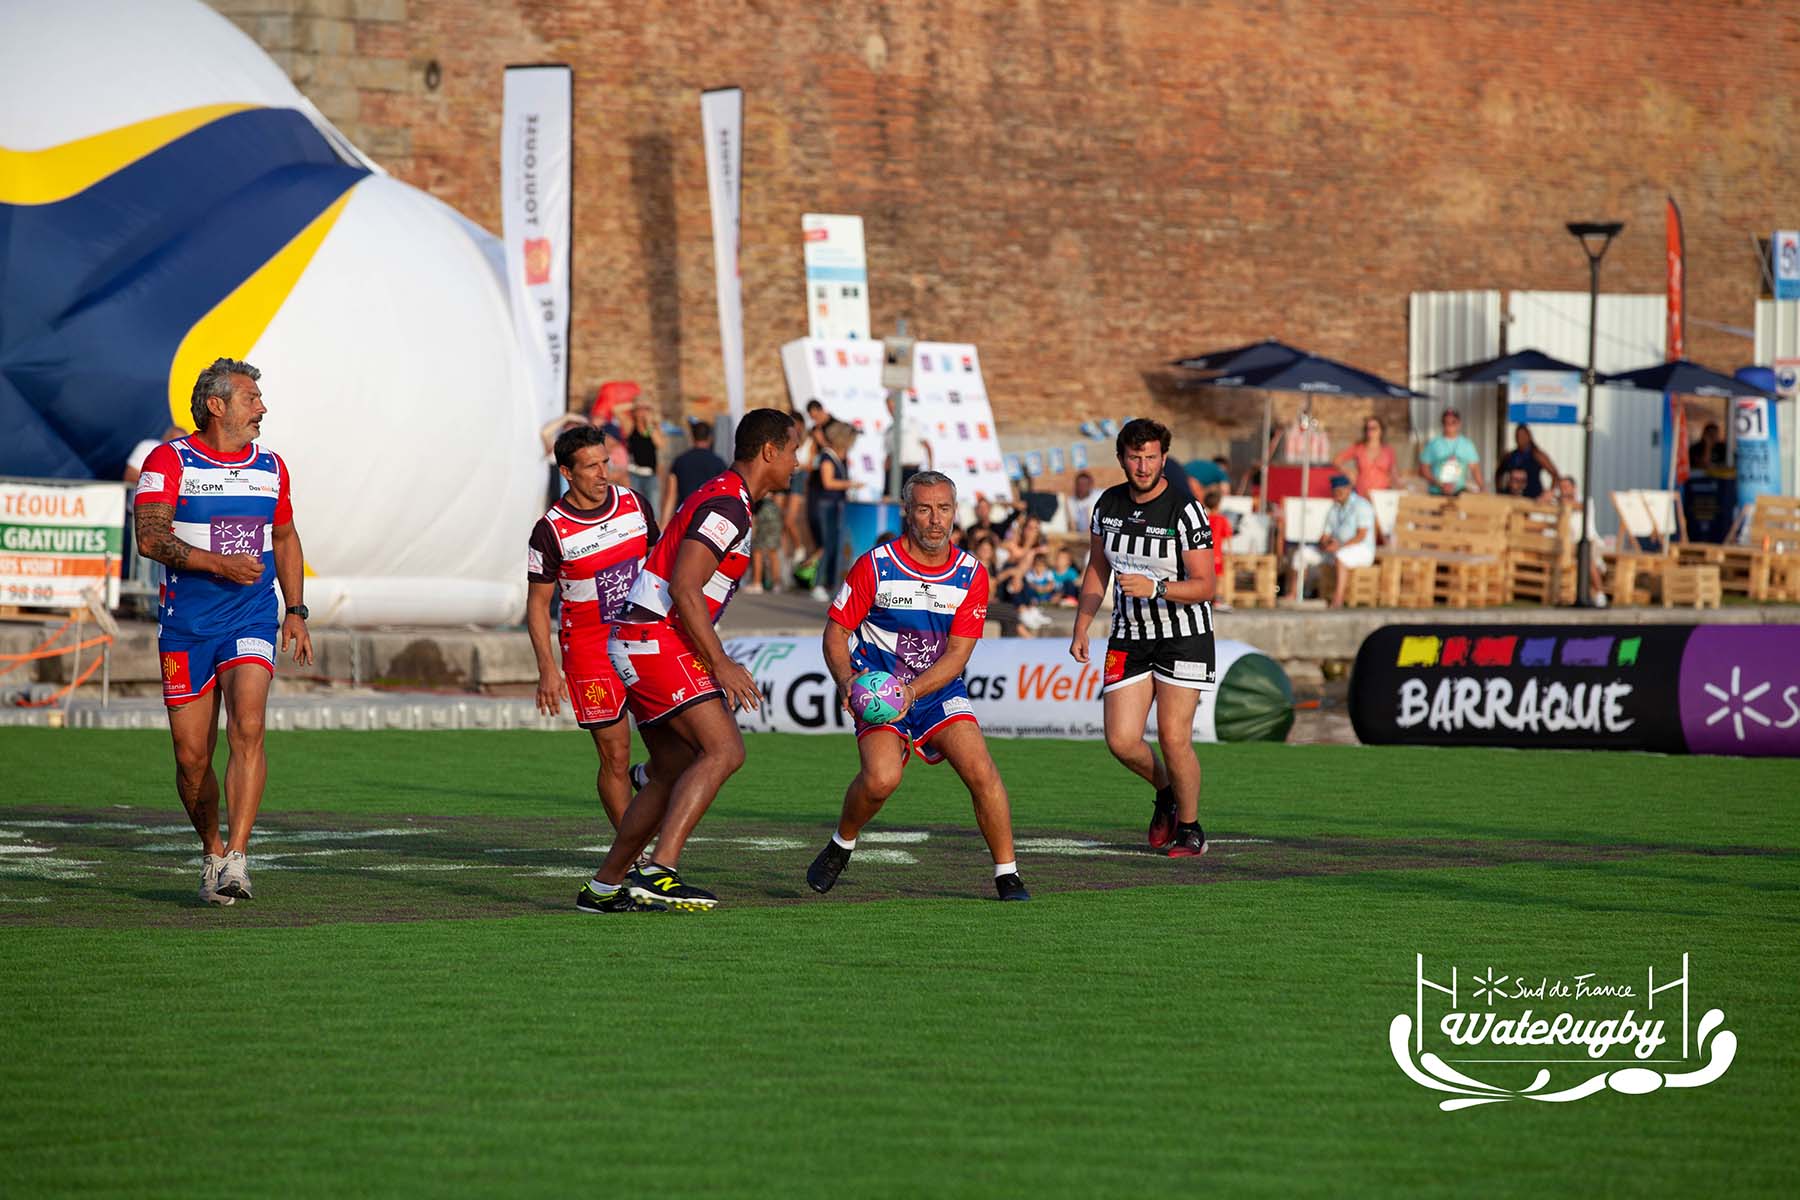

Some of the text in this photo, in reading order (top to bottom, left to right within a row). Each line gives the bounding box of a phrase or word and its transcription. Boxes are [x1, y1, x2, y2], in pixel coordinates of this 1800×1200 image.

[202, 484, 224, 492] GPM
[5, 491, 86, 518] TÉOULA
[232, 525, 259, 539] Sud
[4, 528, 107, 553] GRATUITES
[235, 539, 251, 548] de
[613, 565, 633, 584] Sud
[617, 582, 630, 593] de
[917, 639, 940, 653] Sud
[918, 652, 930, 662] de
[962, 663, 1104, 701] as Welt
[1396, 676, 1636, 734] BARRAQUE
